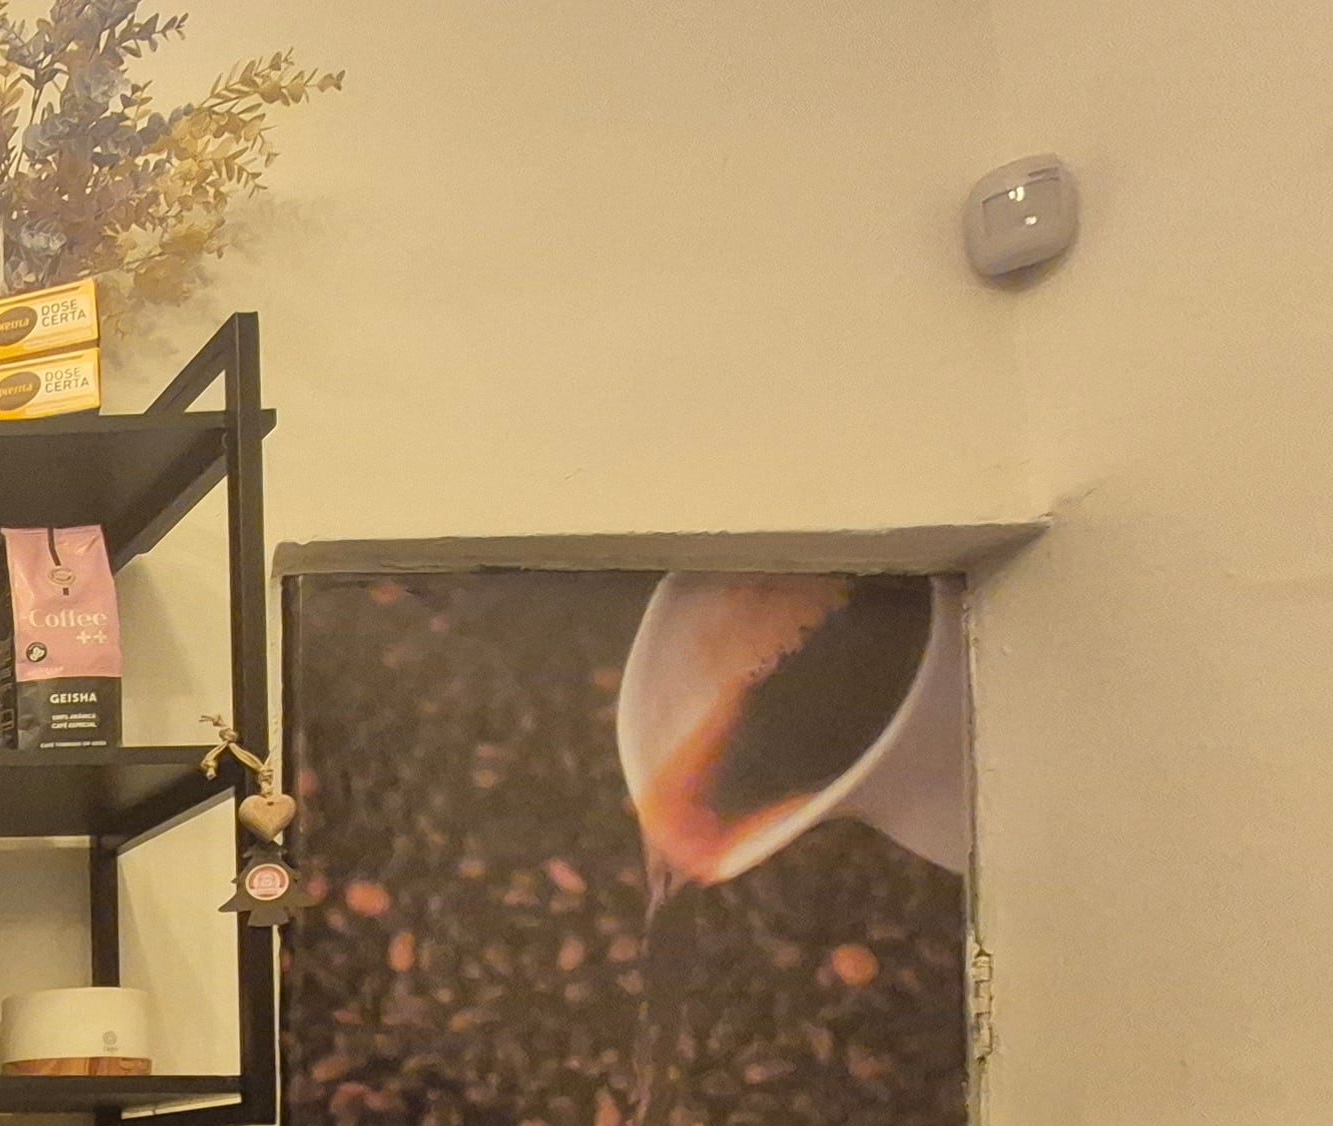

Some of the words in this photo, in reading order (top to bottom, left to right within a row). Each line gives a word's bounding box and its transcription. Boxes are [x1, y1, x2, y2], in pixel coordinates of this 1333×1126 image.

[41, 299, 78, 317] DOSE
[41, 309, 86, 327] CERTA
[45, 367, 81, 382] DOSE
[45, 377, 89, 394] CERTA
[28, 609, 108, 628] Coffee
[50, 692, 97, 703] GEISHA
